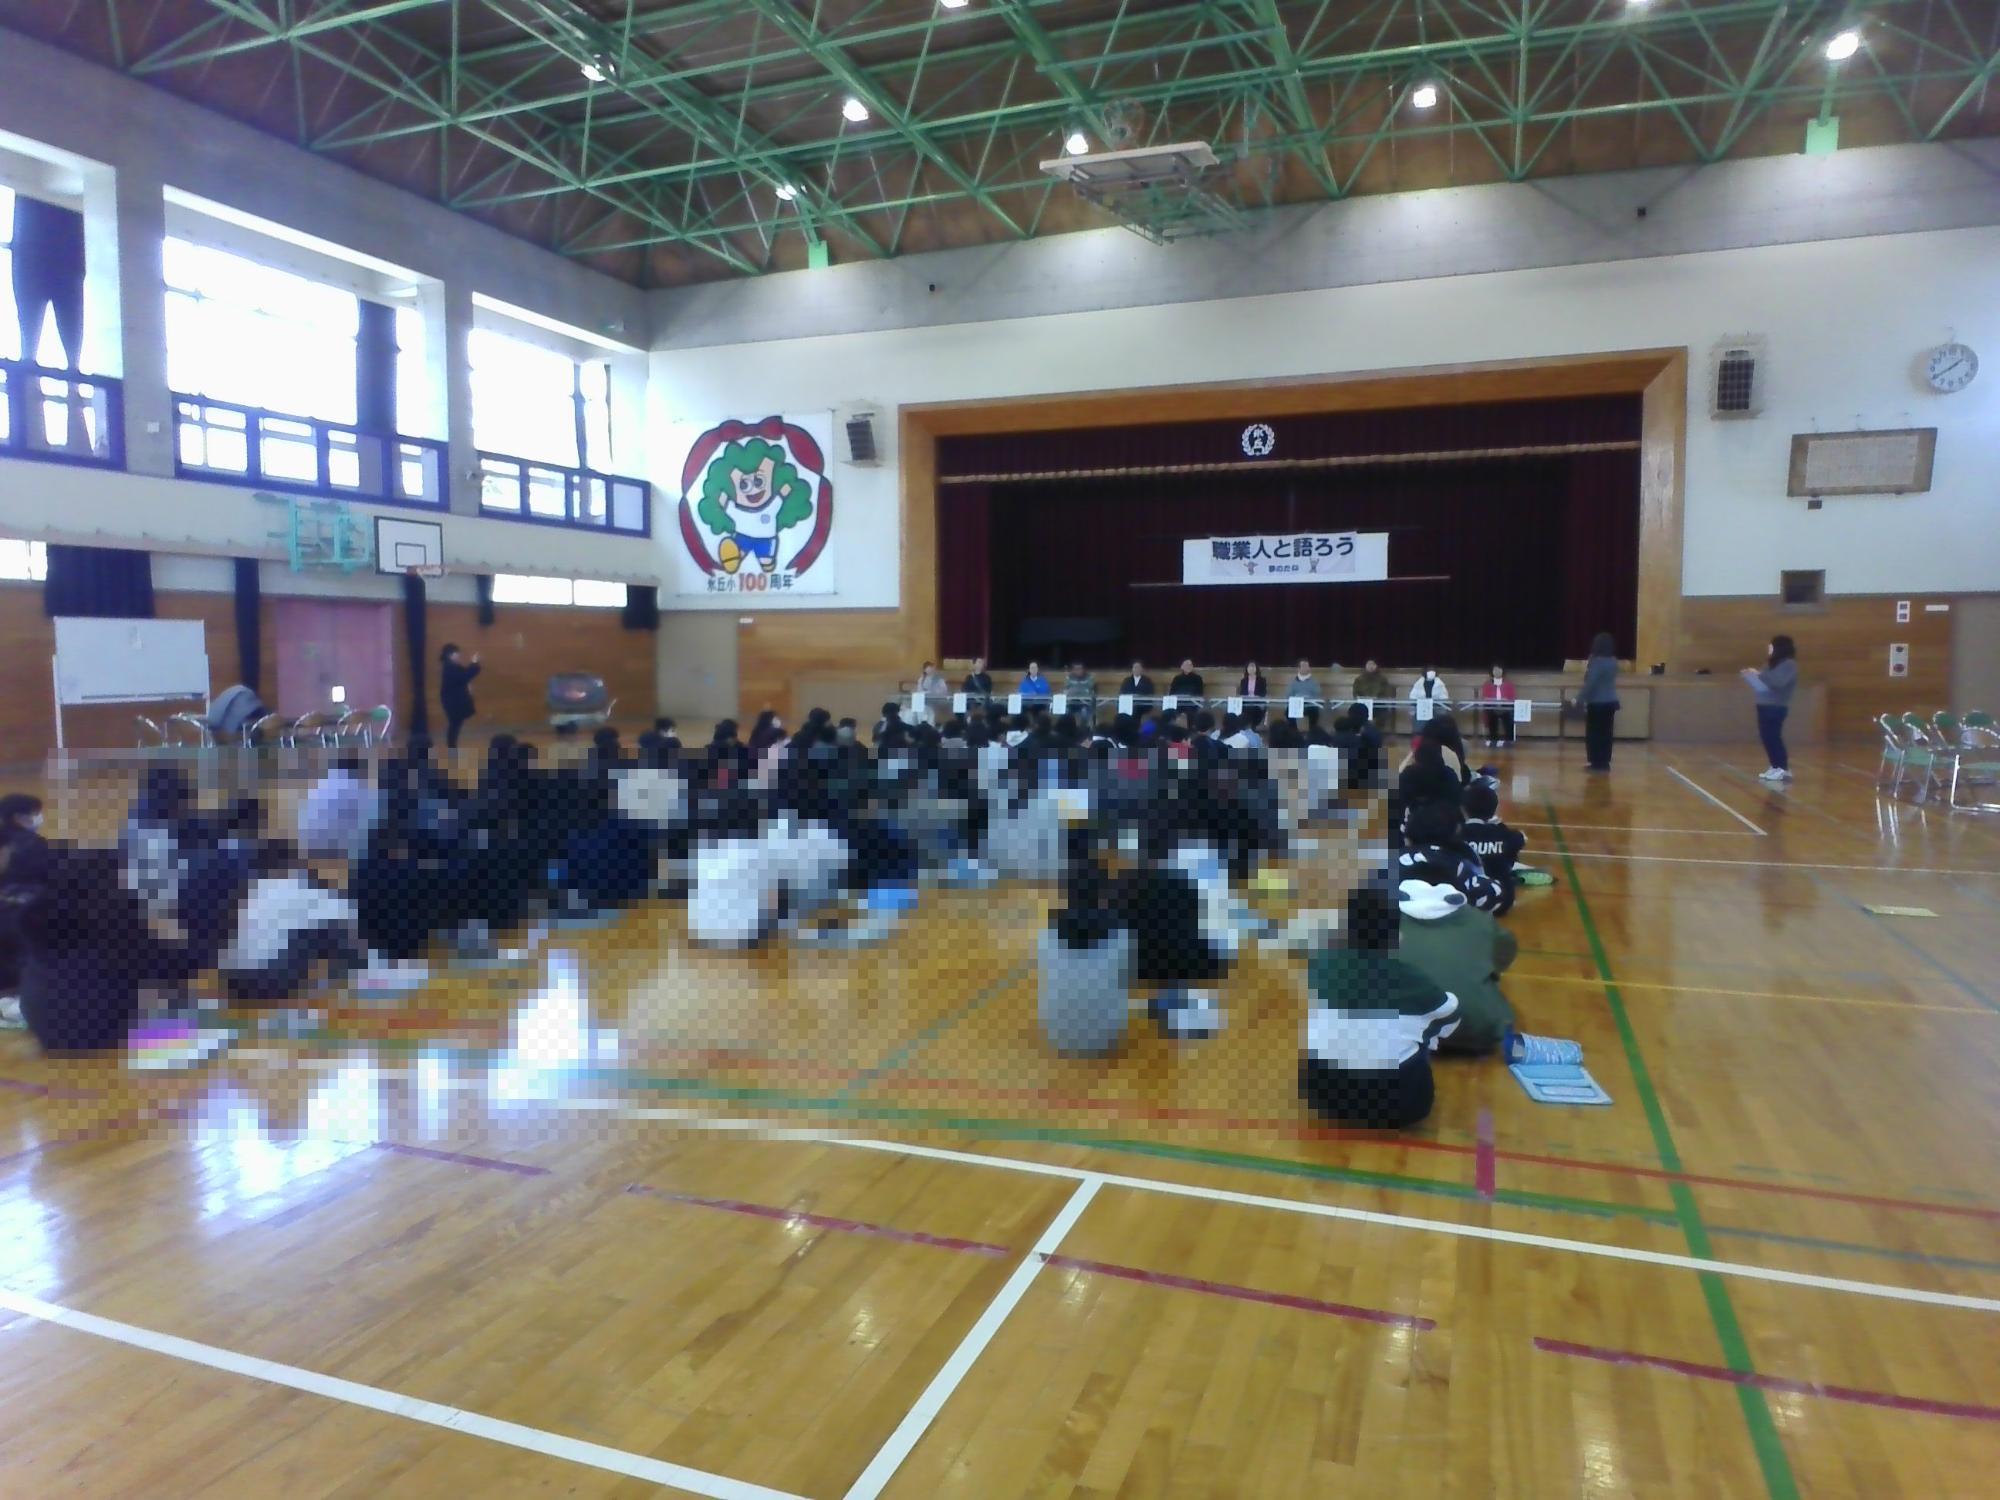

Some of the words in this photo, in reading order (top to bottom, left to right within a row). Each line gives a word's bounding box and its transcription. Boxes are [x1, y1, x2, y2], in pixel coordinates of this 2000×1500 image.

[1212, 537, 1354, 560] 職業人と語ろう
